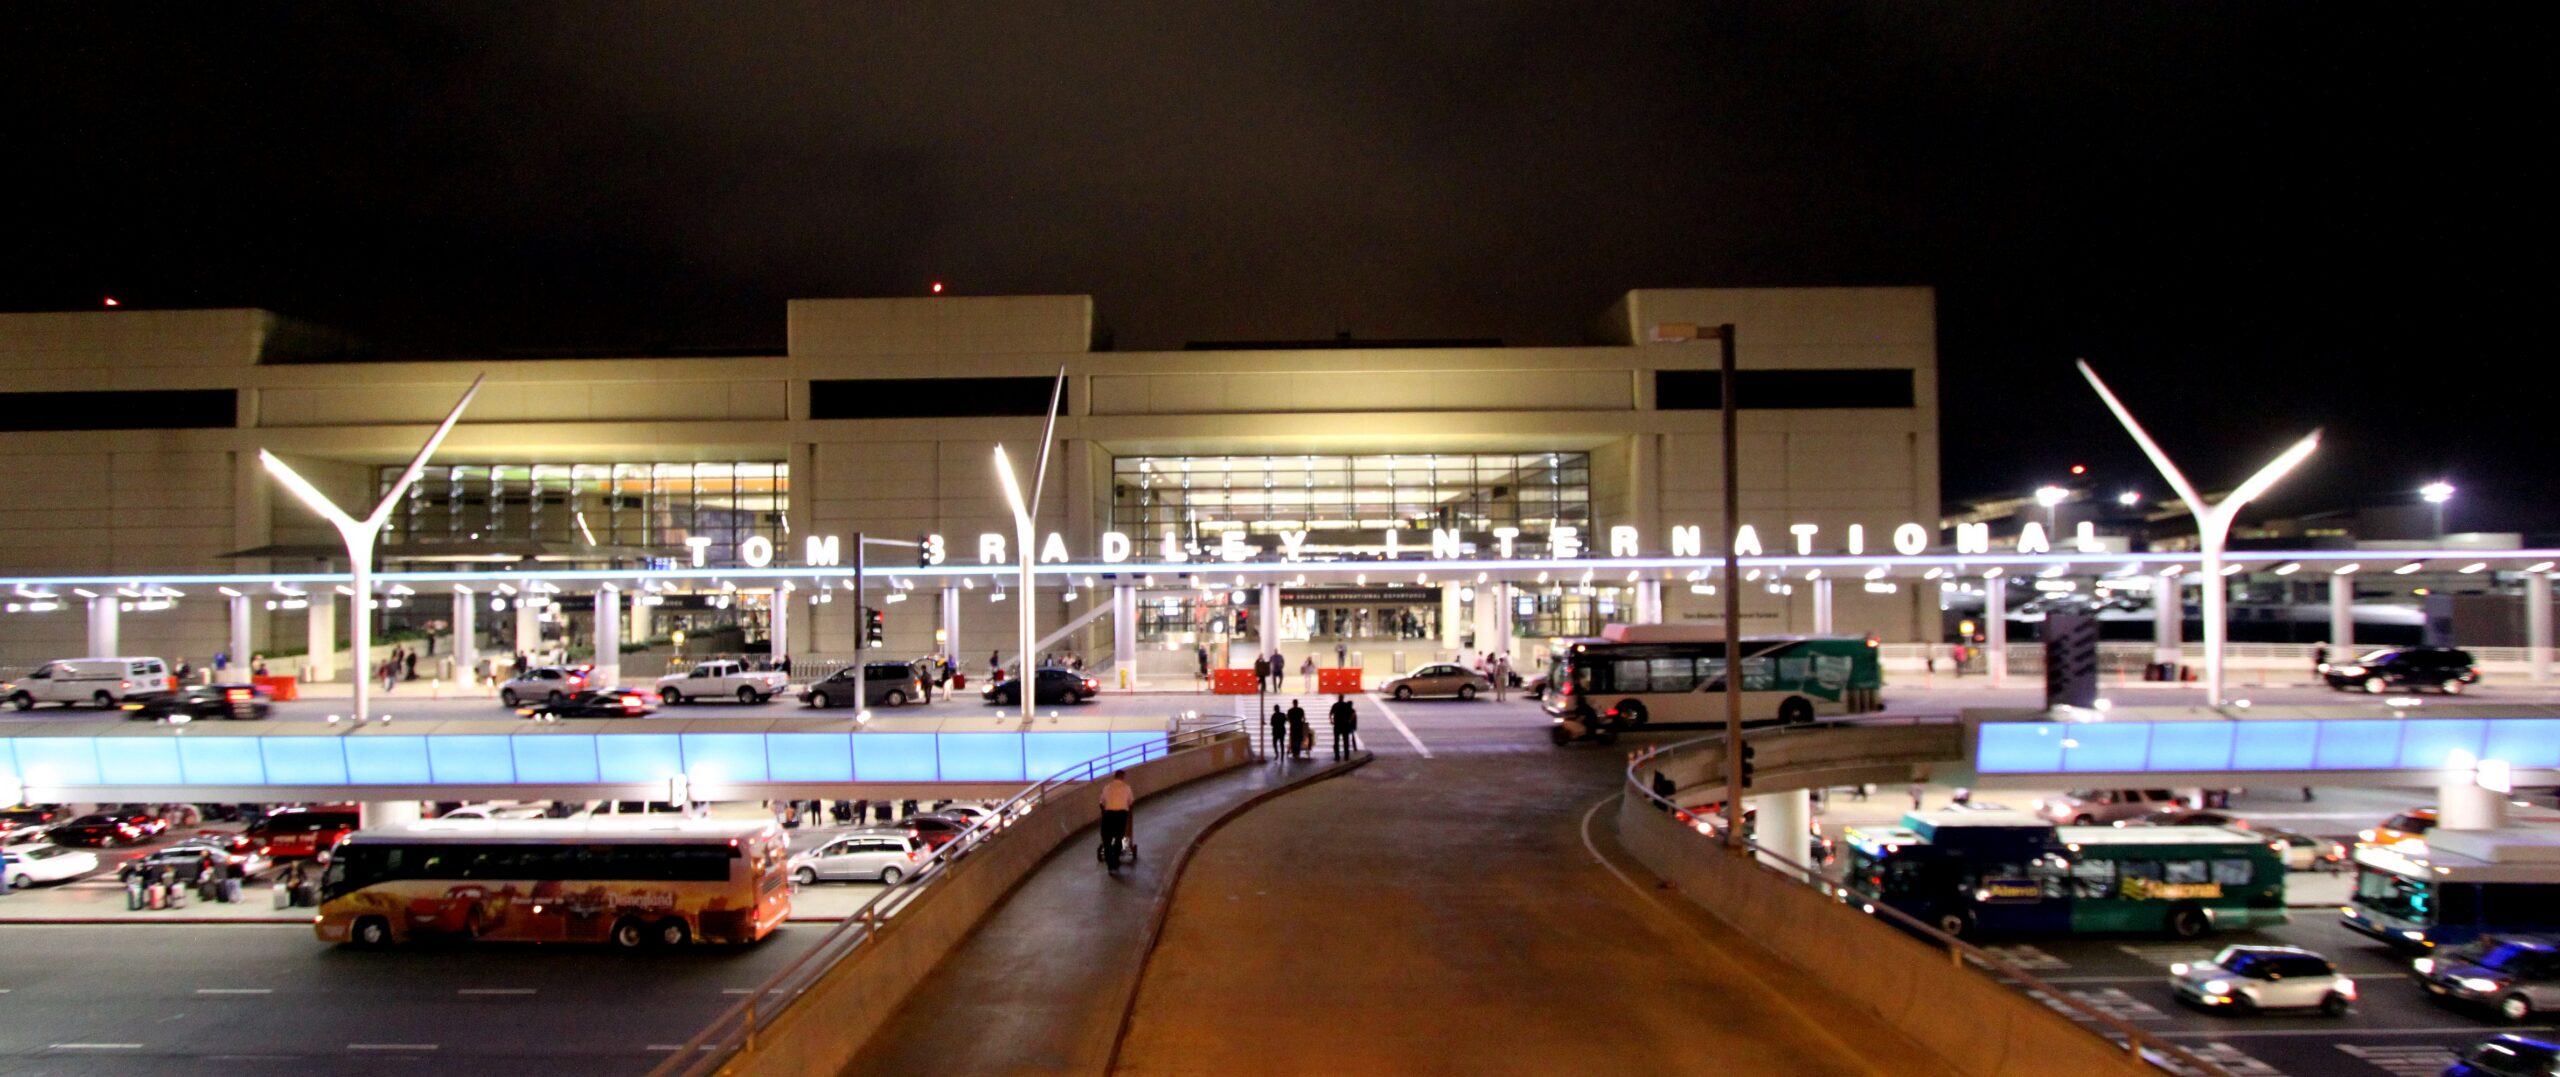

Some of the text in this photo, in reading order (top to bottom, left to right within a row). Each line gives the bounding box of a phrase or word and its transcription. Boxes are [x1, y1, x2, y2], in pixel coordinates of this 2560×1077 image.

[685, 520, 2107, 567] TOM BRADLEY INTERNATIONAL
[1989, 884, 2039, 898] Alamo
[2144, 878, 2225, 899] National
[608, 892, 674, 909] Disneyland
